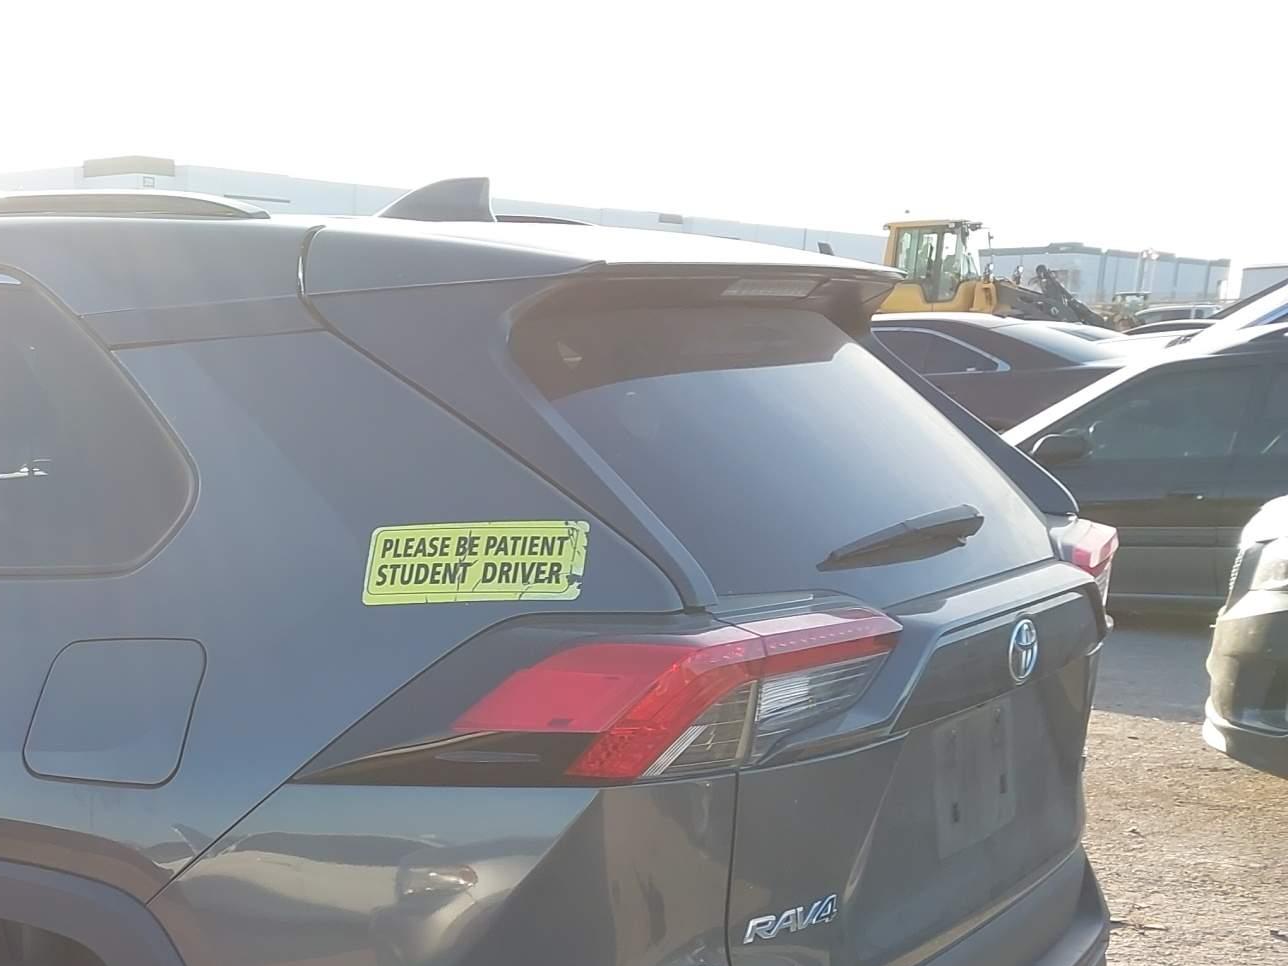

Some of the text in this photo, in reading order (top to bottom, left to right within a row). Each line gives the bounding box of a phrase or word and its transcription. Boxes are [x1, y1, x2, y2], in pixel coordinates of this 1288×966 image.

[381, 535, 569, 558] PLEASE BE PATIENT
[375, 561, 563, 586] STUDENT DRIVER
[743, 894, 838, 944] RAV4
